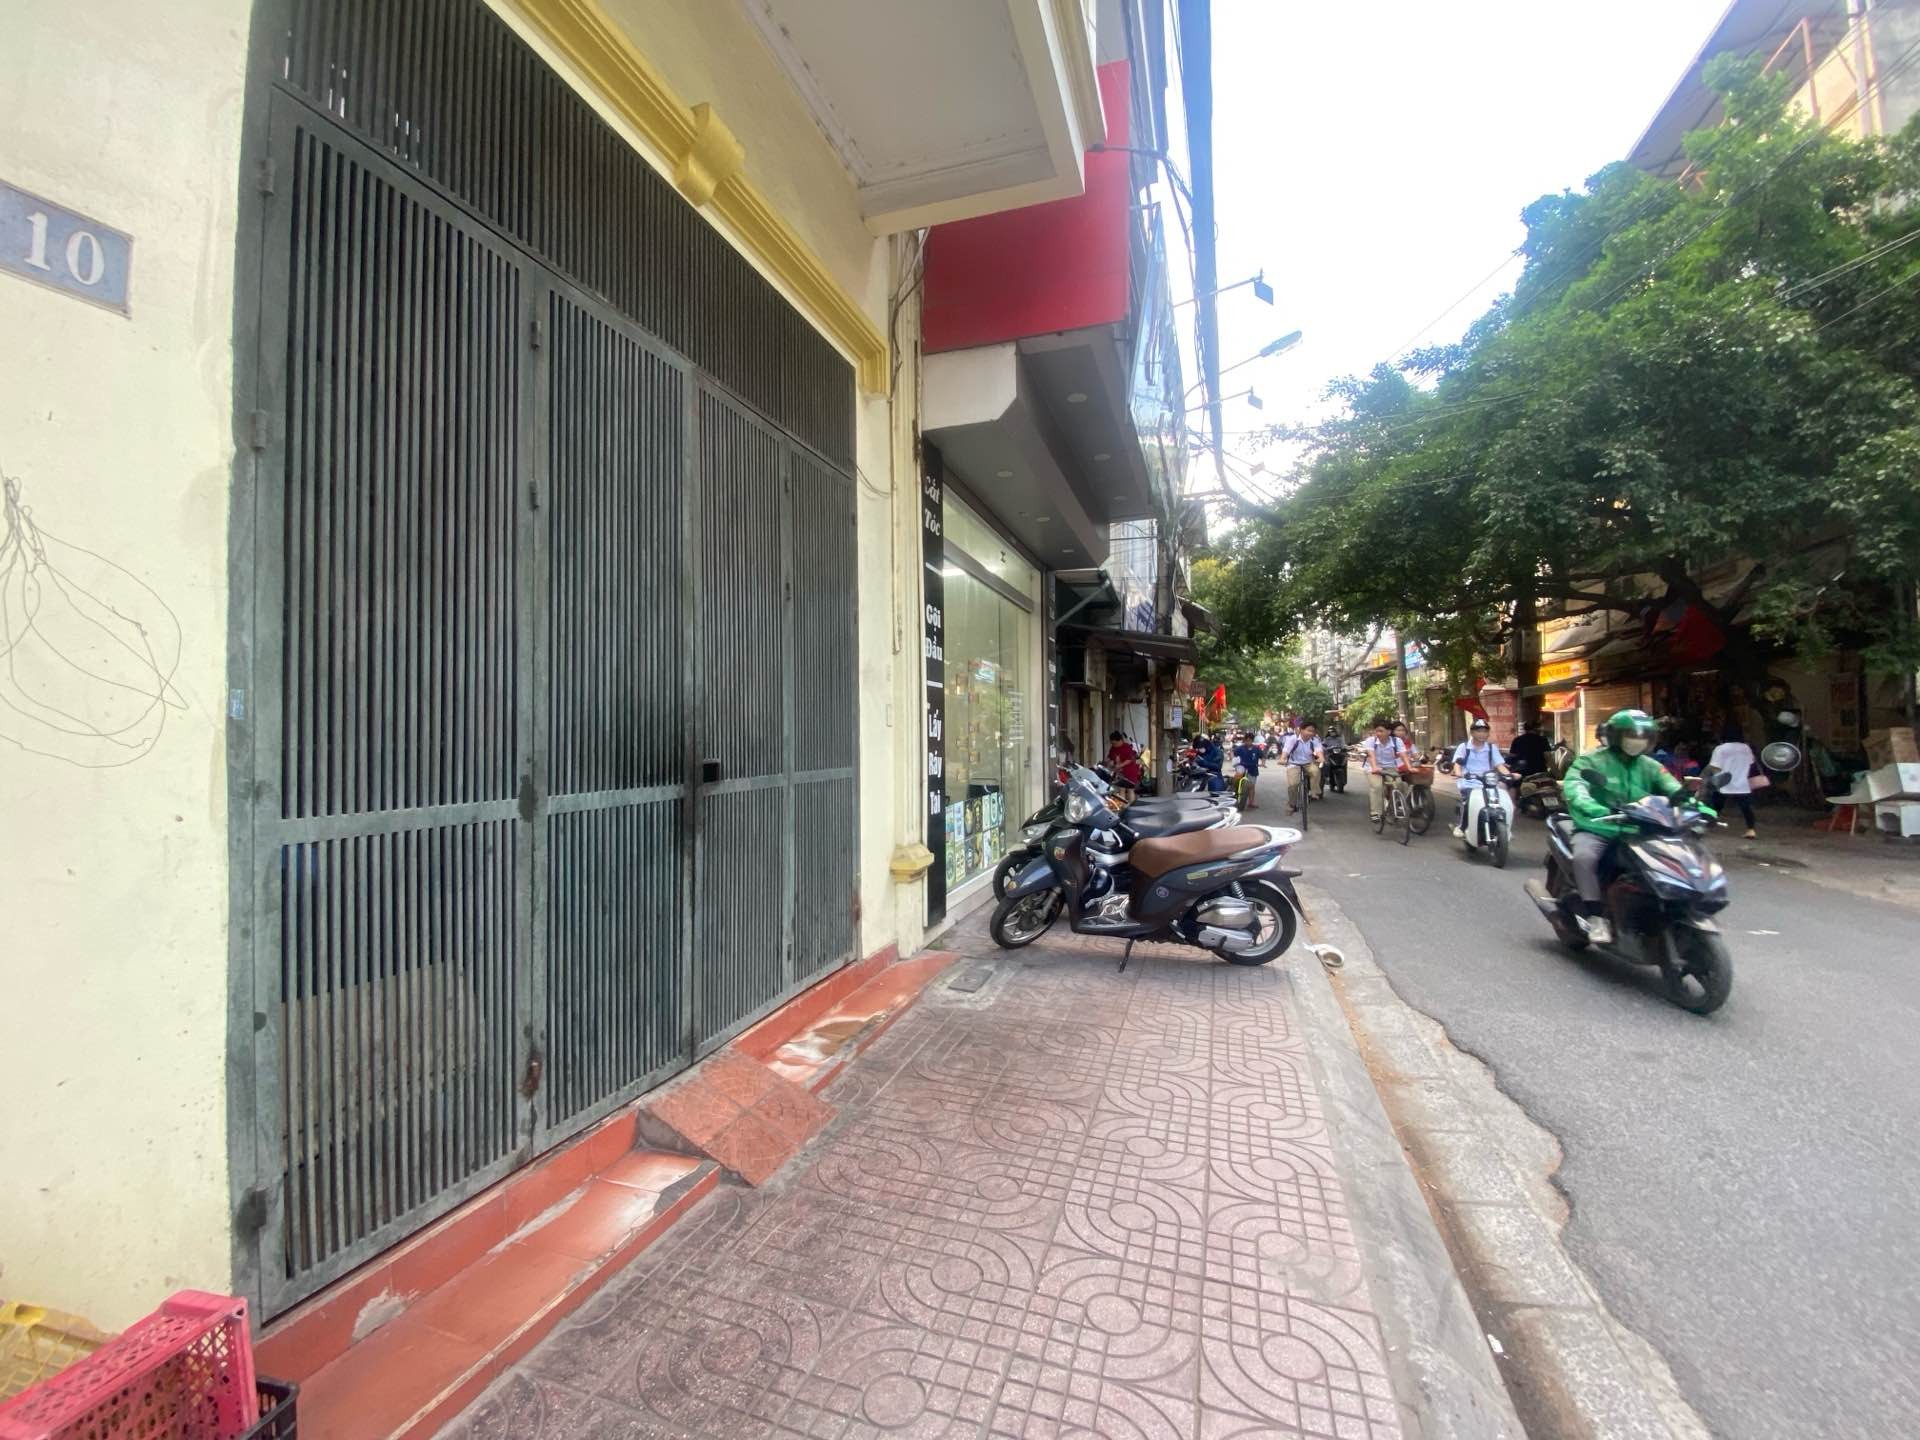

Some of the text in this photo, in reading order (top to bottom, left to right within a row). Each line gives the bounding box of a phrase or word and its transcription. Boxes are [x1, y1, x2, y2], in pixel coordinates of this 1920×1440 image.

[24, 211, 105, 285] 10
[924, 507, 941, 536] Tóc
[929, 790, 941, 815] Tai
